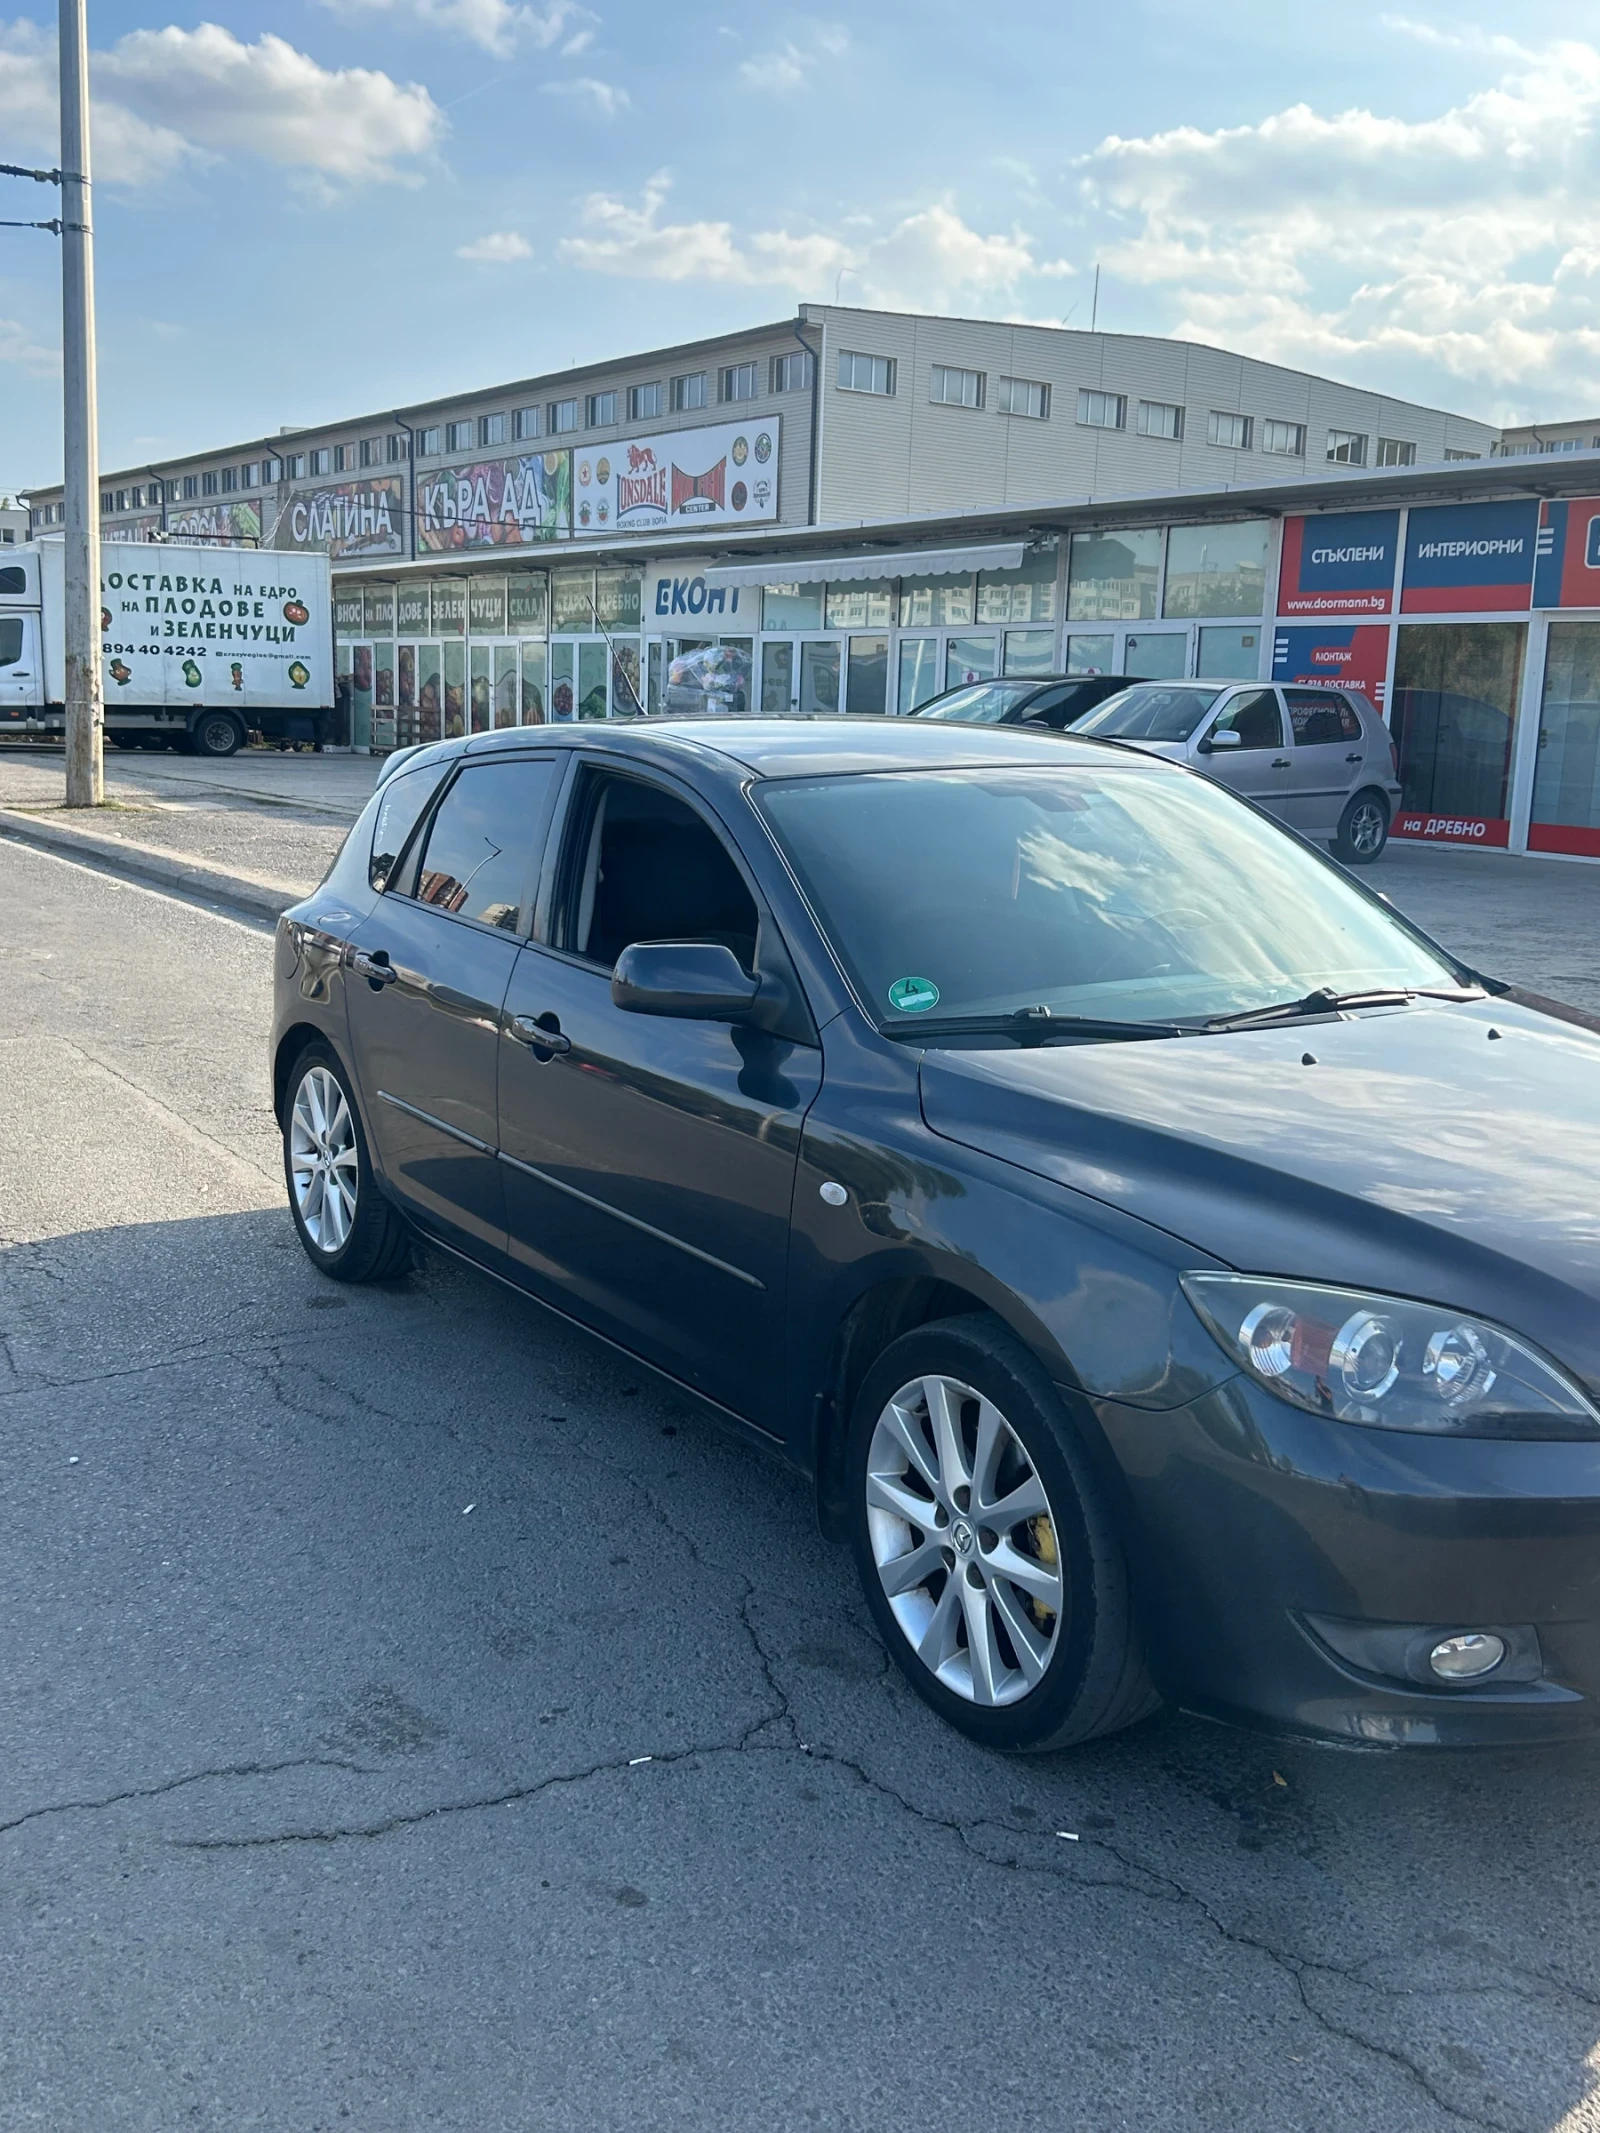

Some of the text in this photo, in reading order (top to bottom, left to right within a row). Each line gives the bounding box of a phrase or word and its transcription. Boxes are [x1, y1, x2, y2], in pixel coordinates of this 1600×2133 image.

[424, 477, 491, 531] КЪРА
[499, 468, 542, 528] АД
[616, 467, 668, 519] LONSDALE
[292, 491, 393, 541] СЛАТИНА
[685, 504, 710, 513] CENTER
[616, 516, 668, 529] BOXING CLUB SOFIA
[1311, 546, 1385, 564] СТЪКЛЕНИ
[1418, 538, 1524, 559] ИНТЕРИОРНИ
[234, 584, 253, 596] НА
[260, 586, 297, 599] ЕДРО
[122, 597, 265, 618] НА ПЛОДОВЕ
[510, 596, 546, 619] СКЛАД
[1287, 596, 1386, 611] www.doormann.bg
[150, 620, 296, 644] И ЗЕЛЕНЧУЦИ
[139, 644, 160, 655] 40
[164, 645, 207, 657] 4242
[1315, 652, 1352, 661] МОНТАЖ
[1323, 680, 1366, 690] ДОСТАВКА
[1403, 819, 1486, 837] на ДРЕБНО
